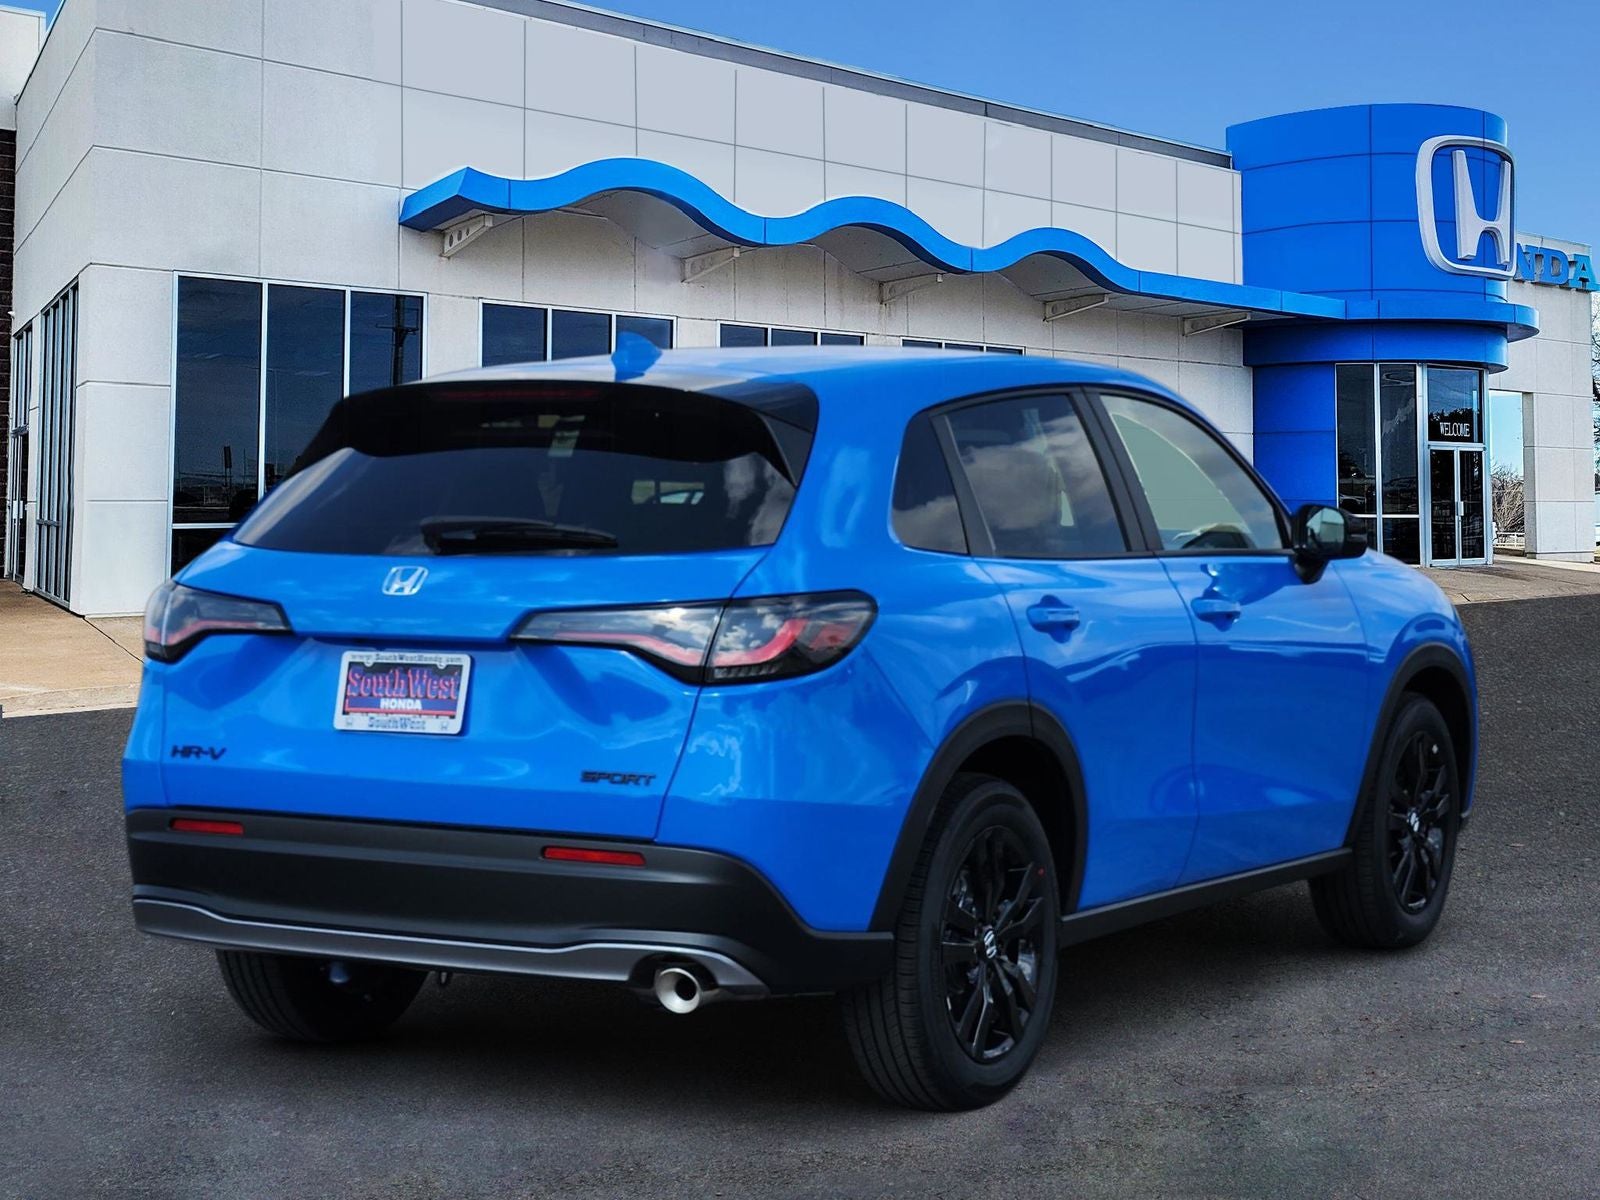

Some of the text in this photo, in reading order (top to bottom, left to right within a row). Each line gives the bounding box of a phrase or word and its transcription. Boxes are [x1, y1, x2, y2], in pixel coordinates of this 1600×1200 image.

[1515, 242, 1600, 292] NDA
[1439, 421, 1471, 437] WELCOME
[379, 698, 423, 710] HONDA
[170, 744, 228, 761] HR-V
[580, 771, 657, 787] SPORT
